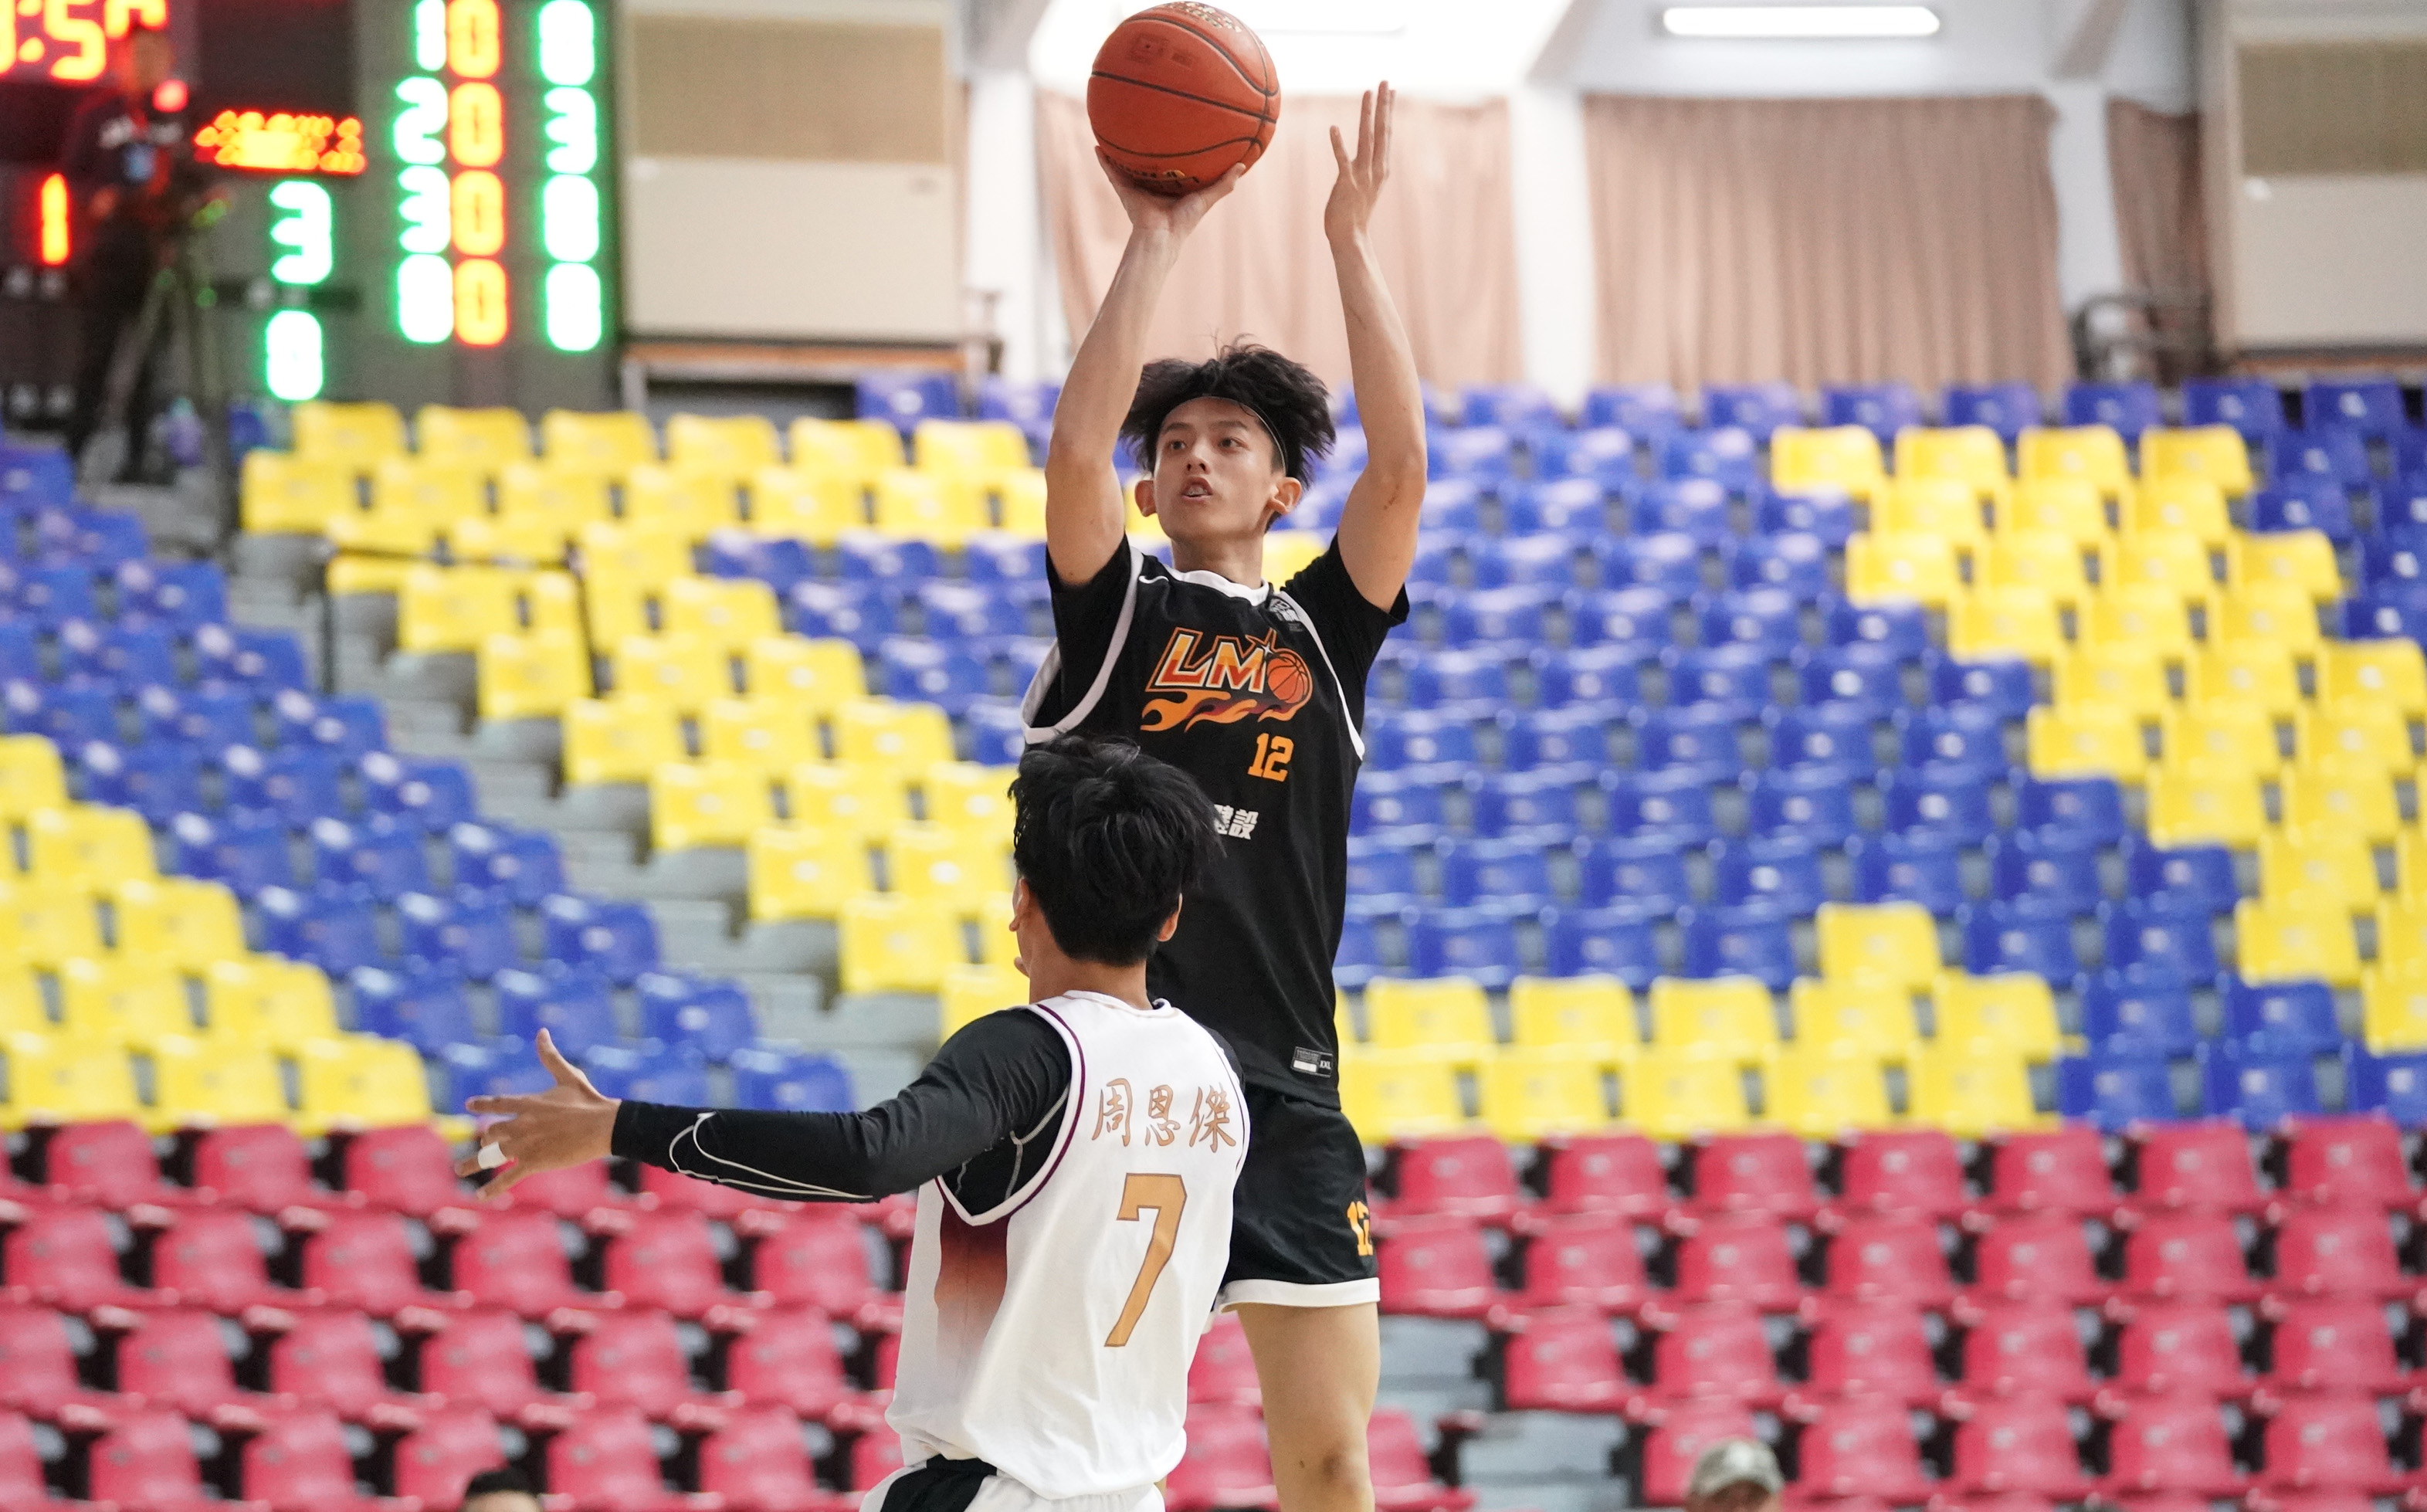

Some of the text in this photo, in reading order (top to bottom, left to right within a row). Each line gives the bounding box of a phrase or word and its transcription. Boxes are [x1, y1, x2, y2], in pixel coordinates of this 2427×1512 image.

[447, 0, 500, 79] 0
[393, 76, 449, 164] 2
[449, 81, 503, 168] 0
[544, 86, 597, 175] 3
[41, 174, 332, 284] 1 3
[398, 165, 452, 253] 3
[451, 169, 504, 256] 0
[454, 259, 508, 346] 0
[1247, 733, 1295, 782] 12
[1091, 1078, 1237, 1154] 周恩傑
[1104, 1172, 1188, 1348] 7
